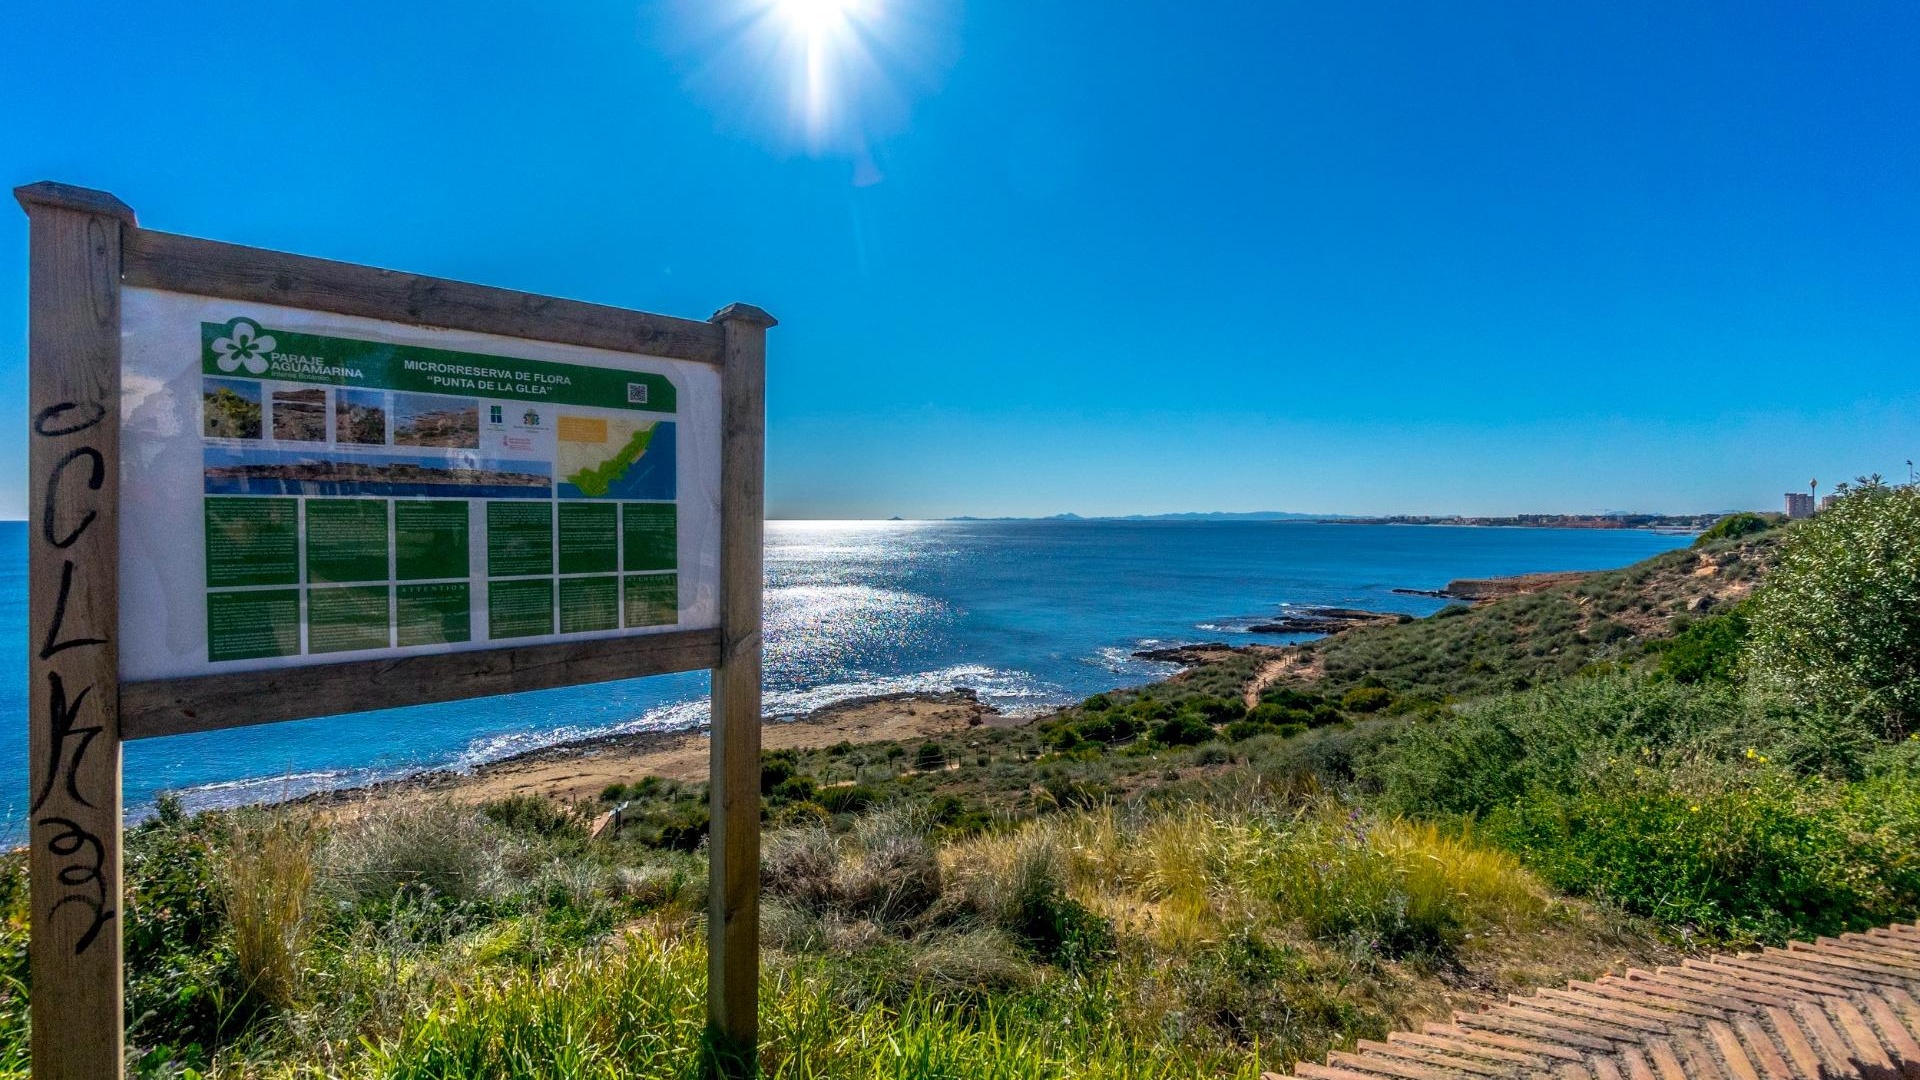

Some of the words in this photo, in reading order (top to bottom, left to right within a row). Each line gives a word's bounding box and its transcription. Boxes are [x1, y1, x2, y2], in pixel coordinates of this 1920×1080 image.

[271, 352, 325, 366] PARAJE
[271, 361, 363, 379] AGUAMARINA
[404, 360, 512, 379] MICRORRESERVA
[515, 371, 530, 381] DE
[534, 373, 572, 385] FLORA
[478, 380, 494, 390] DE
[498, 382, 513, 391] LA
